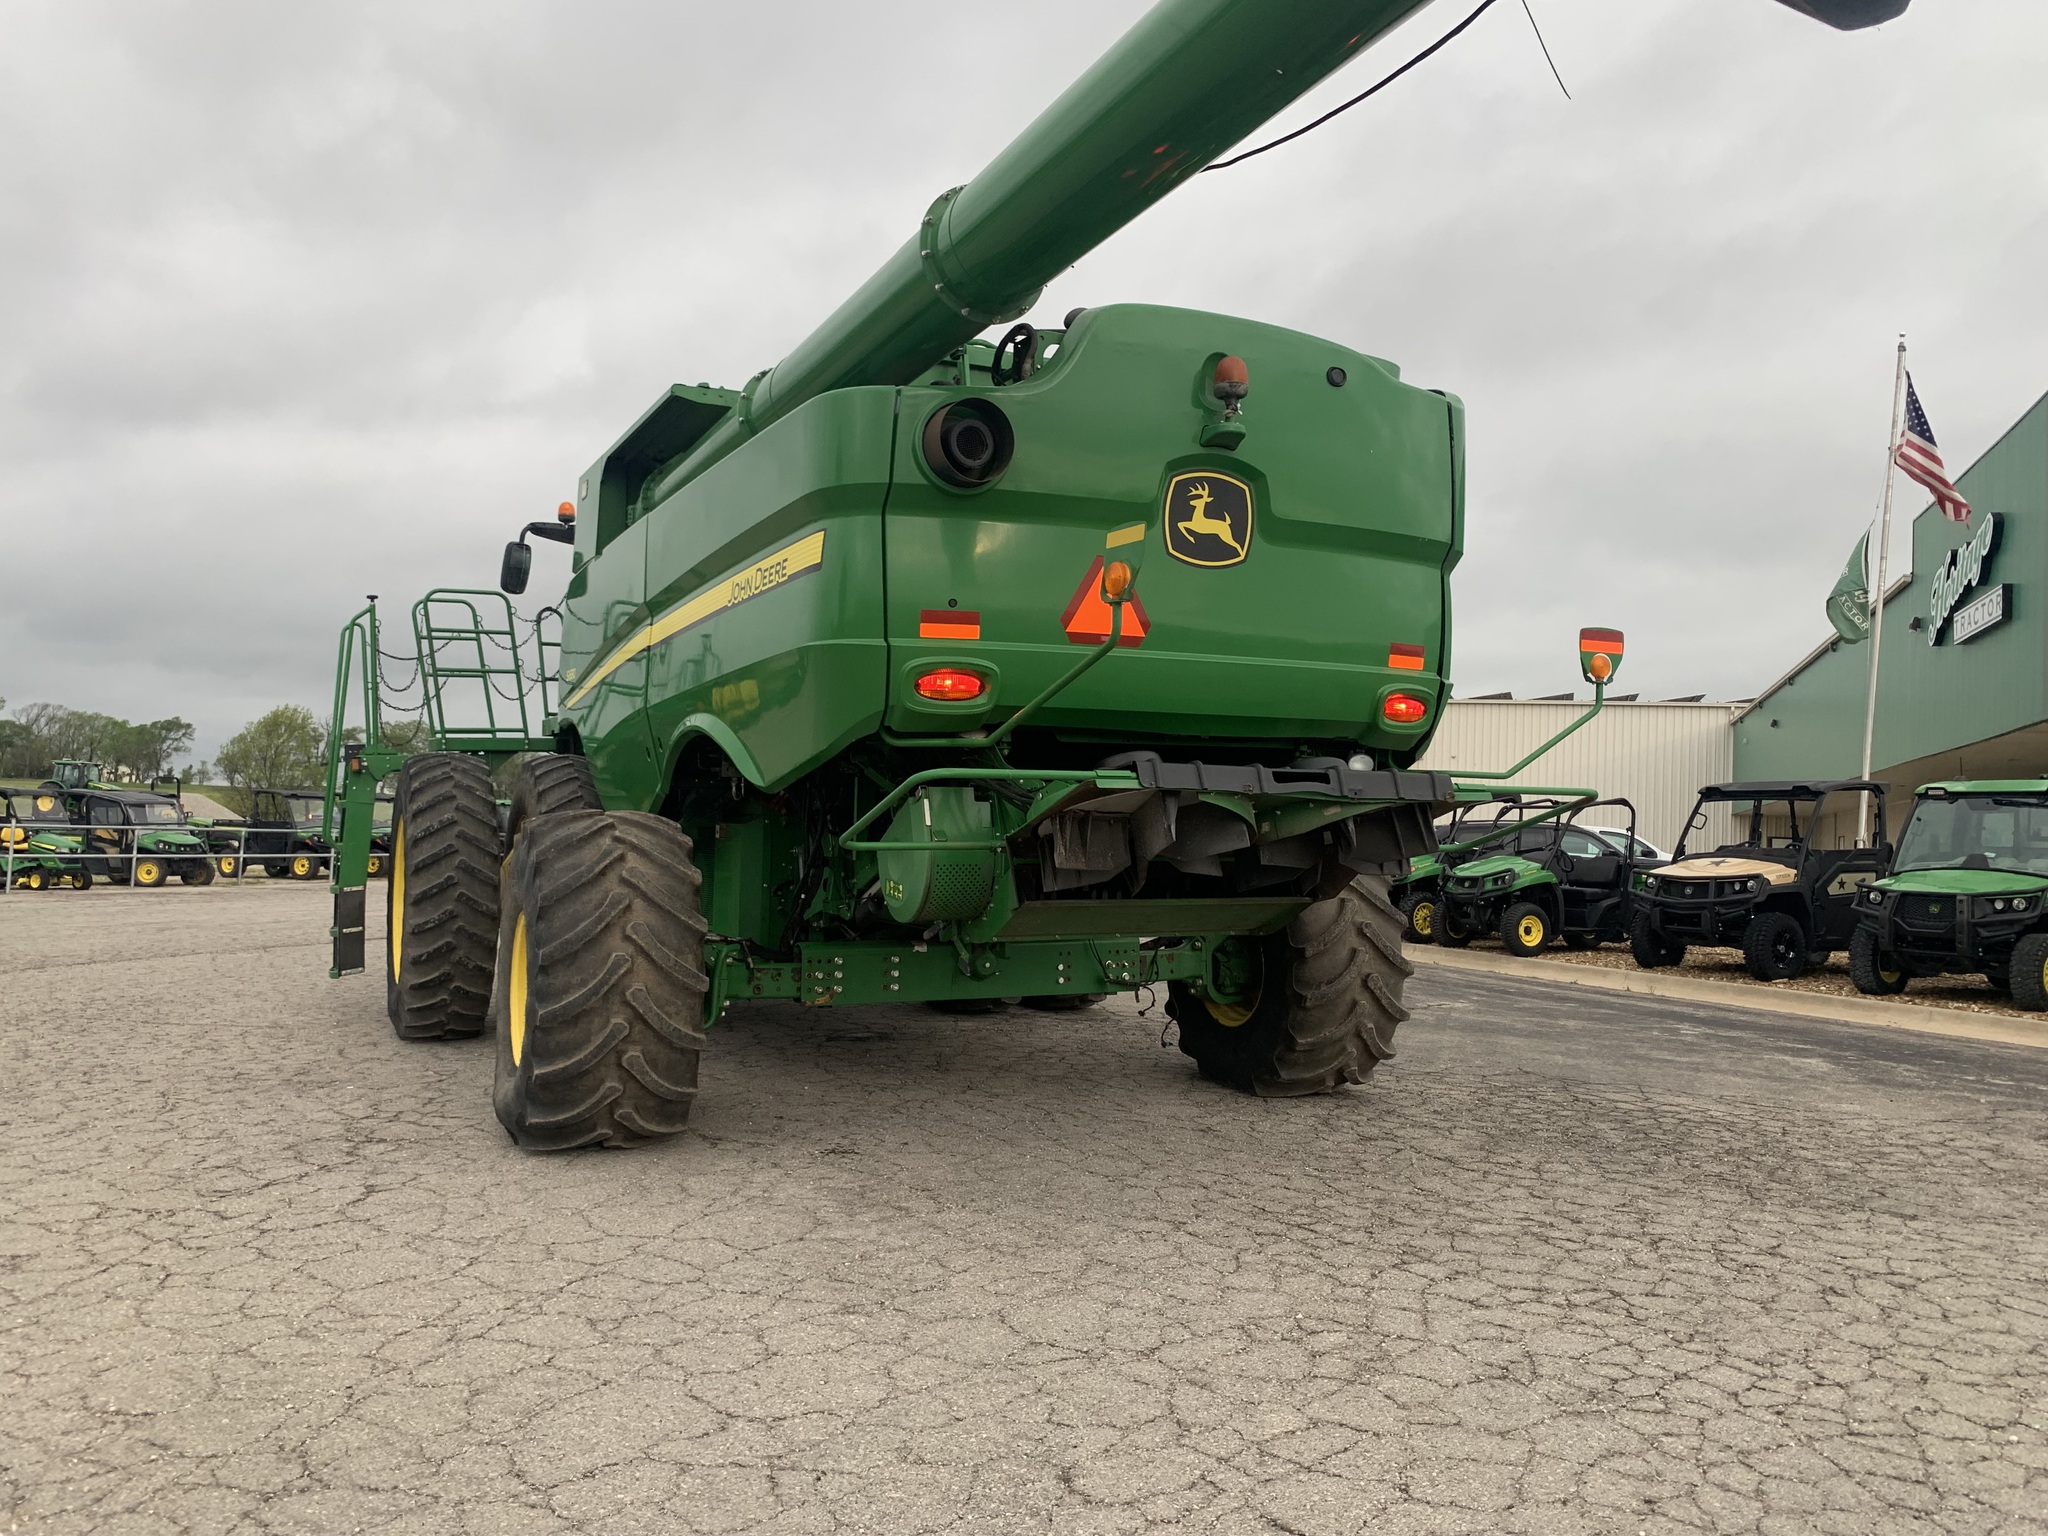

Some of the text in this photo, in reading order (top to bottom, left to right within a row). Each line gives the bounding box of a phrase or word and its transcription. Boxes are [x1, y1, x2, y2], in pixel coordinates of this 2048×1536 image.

[727, 558, 788, 605] JOHN DEERE
[1838, 595, 1869, 630] ACTOR
[1954, 593, 2002, 637] TRACTOR
